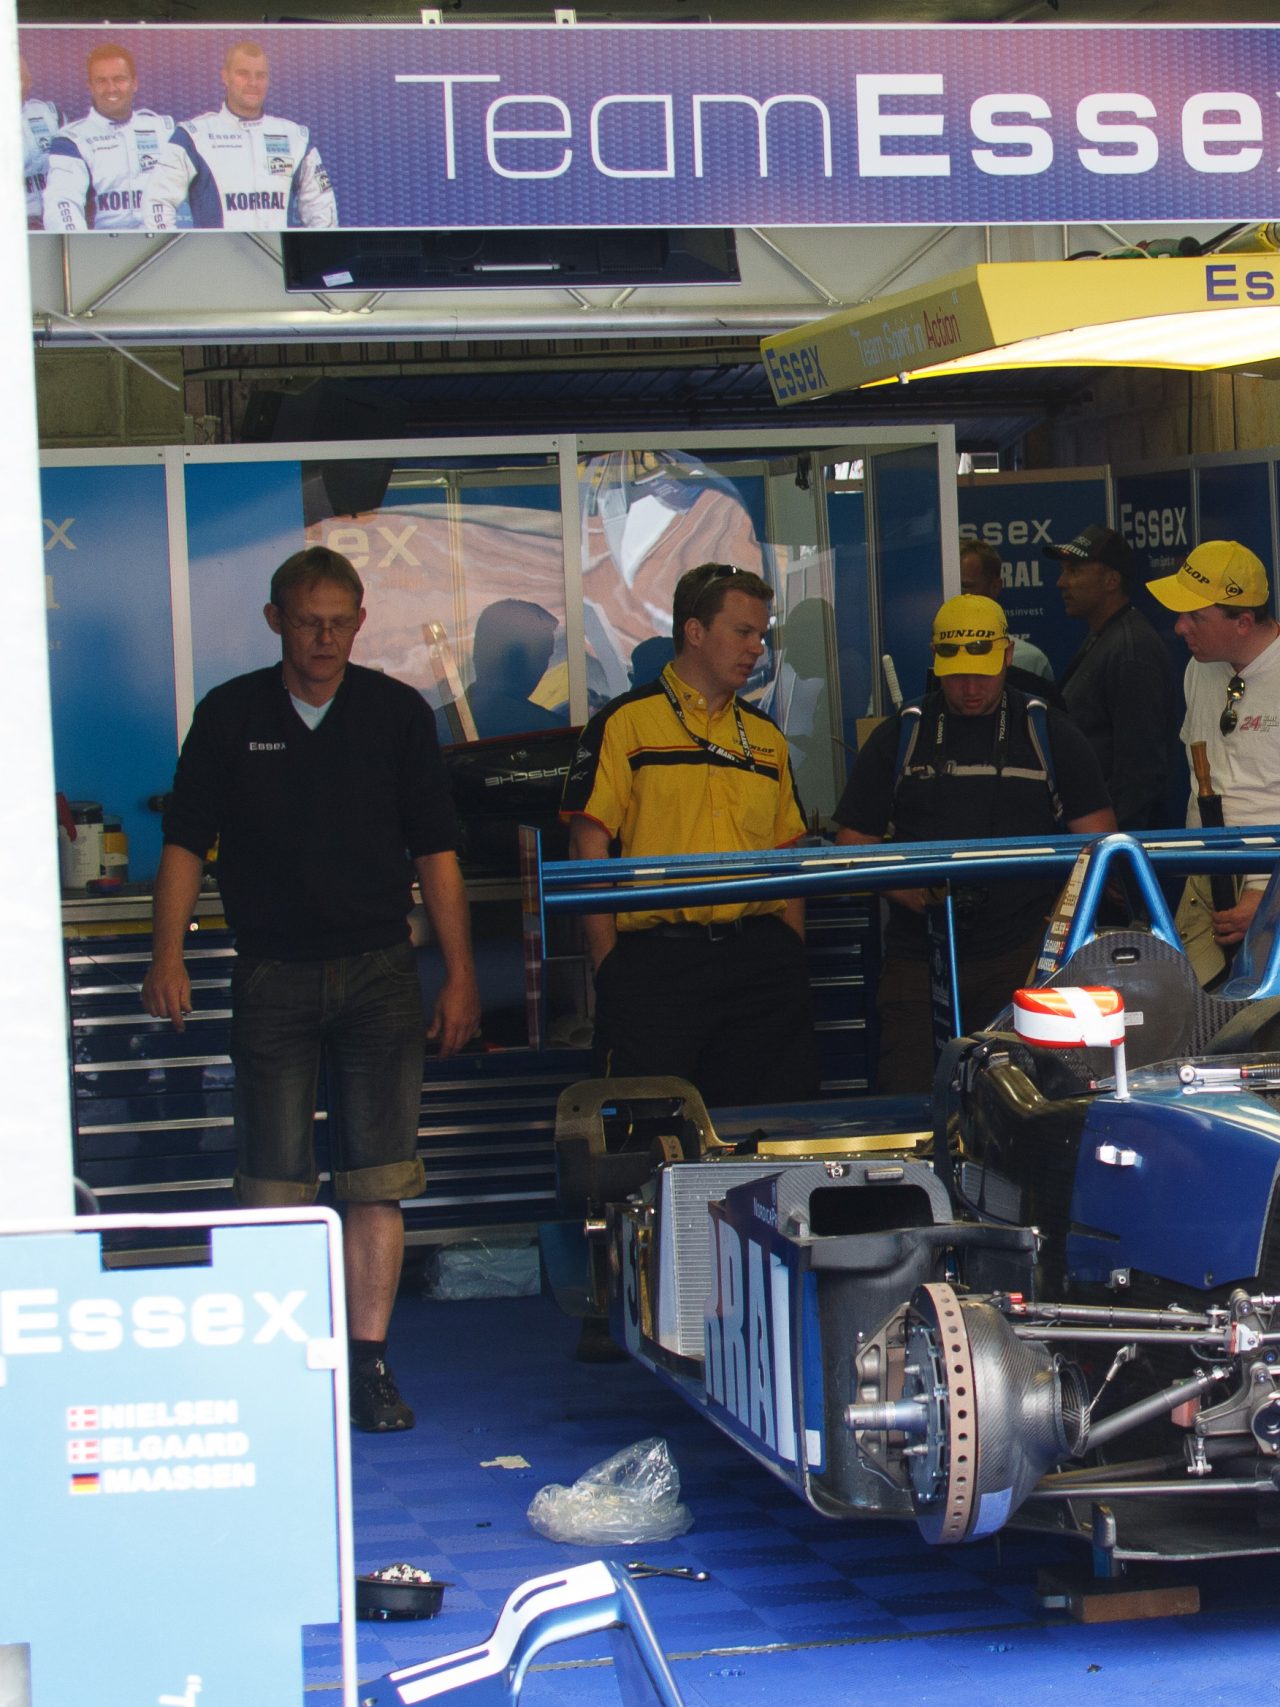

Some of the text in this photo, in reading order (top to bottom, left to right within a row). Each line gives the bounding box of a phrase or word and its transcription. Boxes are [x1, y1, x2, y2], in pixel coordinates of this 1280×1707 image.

[225, 191, 286, 211] KORRAL
[764, 345, 829, 400] Essex
[958, 518, 1053, 546] ssex
[1120, 503, 1188, 550] Essex
[1001, 560, 1044, 589] RAL
[939, 629, 996, 641] DUNLOP
[936, 712, 946, 745] Canon
[1239, 715, 1262, 732] 24
[249, 741, 287, 751] Essex
[0, 1287, 309, 1355] Essex
[101, 1399, 239, 1429] NIELSEN
[101, 1431, 250, 1463] ELGAARD
[102, 1462, 256, 1494] MAASSEN
